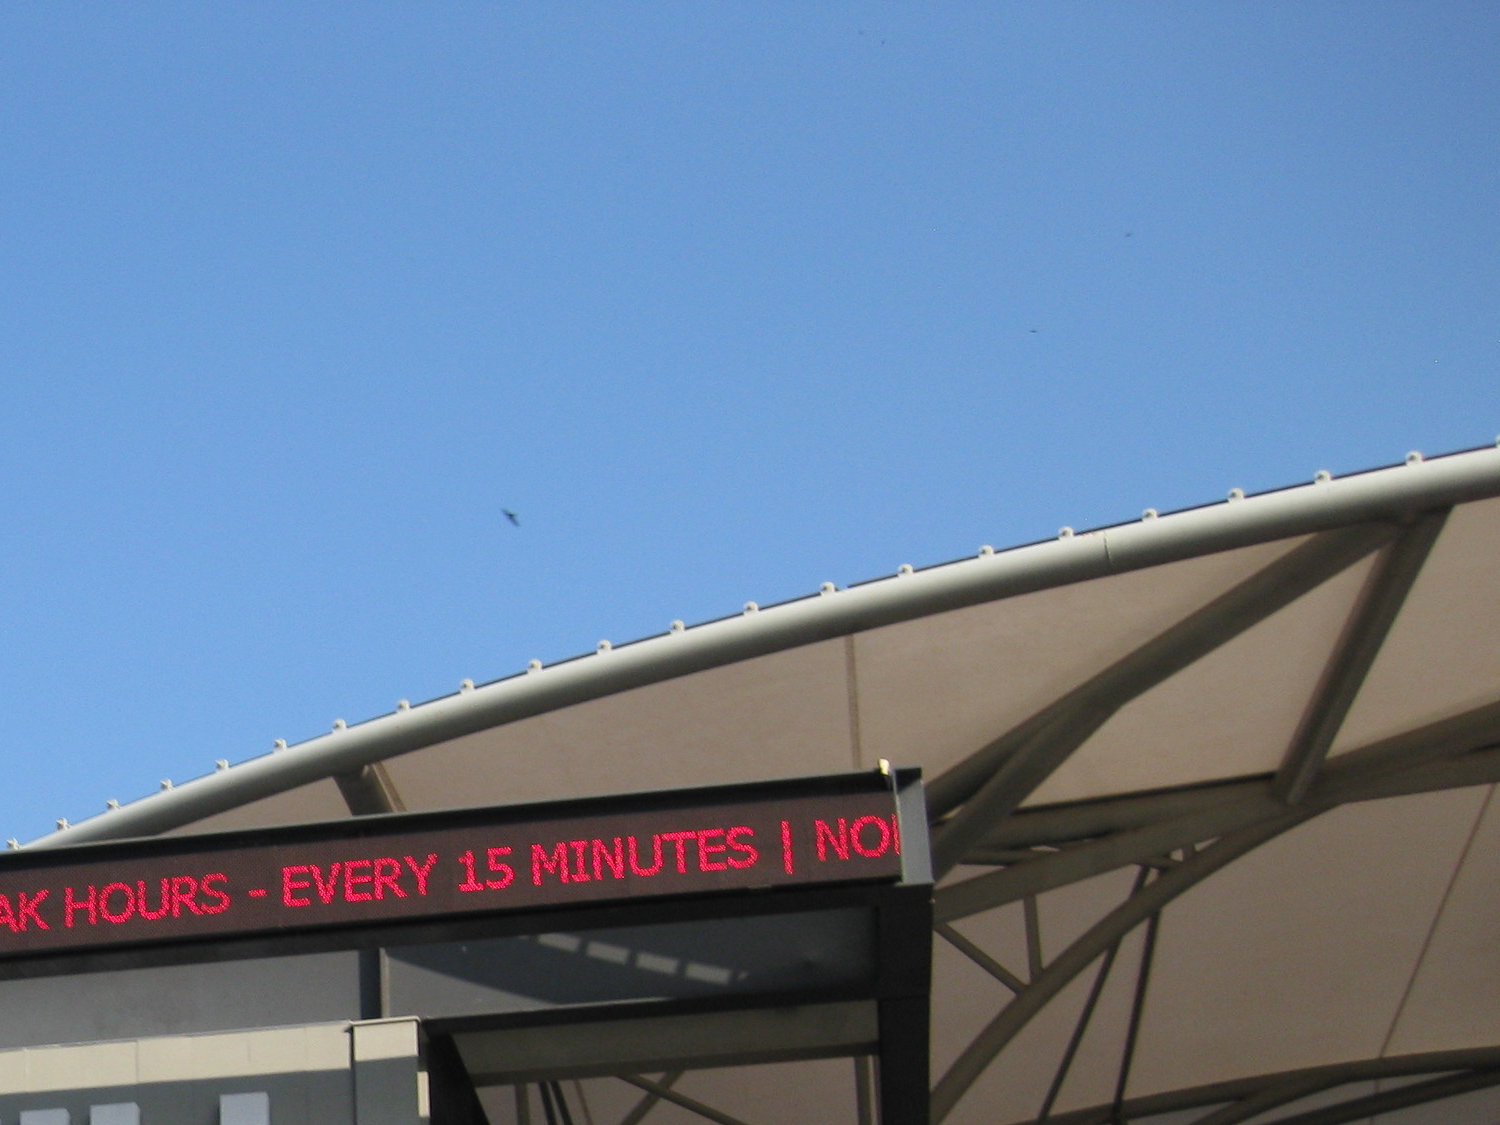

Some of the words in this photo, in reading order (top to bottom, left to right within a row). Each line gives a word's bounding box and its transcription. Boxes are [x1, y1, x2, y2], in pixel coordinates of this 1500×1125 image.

[64, 872, 231, 928] HOURS
[281, 852, 438, 908] EVERY
[457, 846, 516, 893] 15
[531, 826, 760, 887] MINUTES
[813, 813, 900, 862] NO
